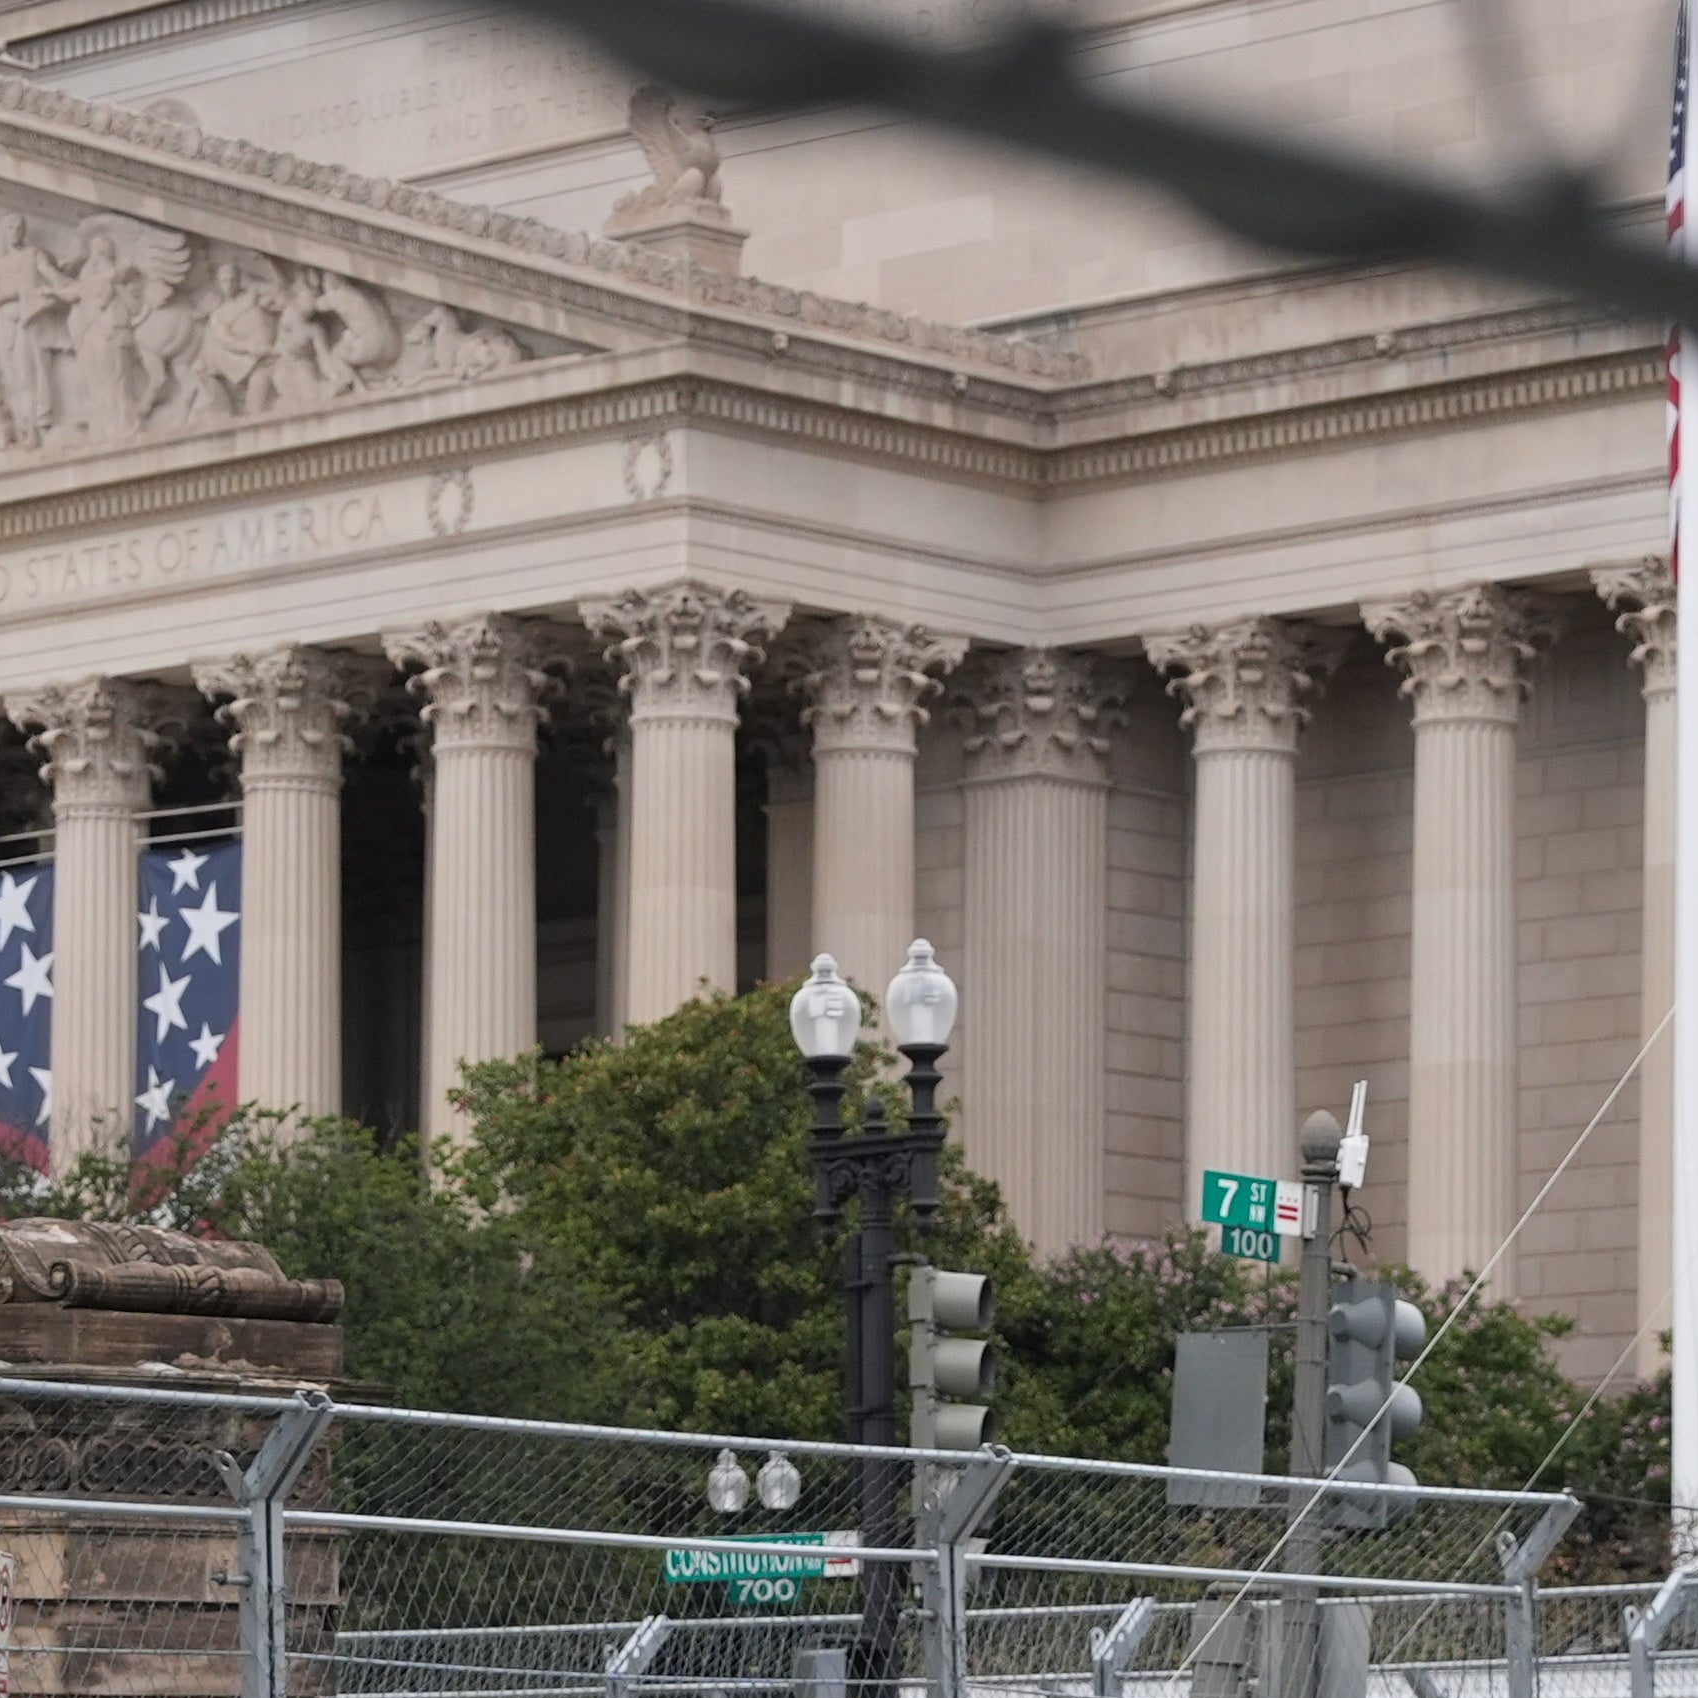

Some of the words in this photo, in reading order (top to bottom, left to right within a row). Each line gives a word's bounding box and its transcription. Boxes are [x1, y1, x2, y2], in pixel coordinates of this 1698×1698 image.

[25, 539, 143, 600] STATES
[154, 528, 200, 576] OF
[208, 494, 388, 569] AMERICA
[1217, 1178, 1239, 1218] 7
[1249, 1182, 1268, 1203] ST
[1230, 1227, 1274, 1259] 100
[736, 1578, 796, 1602] 700
